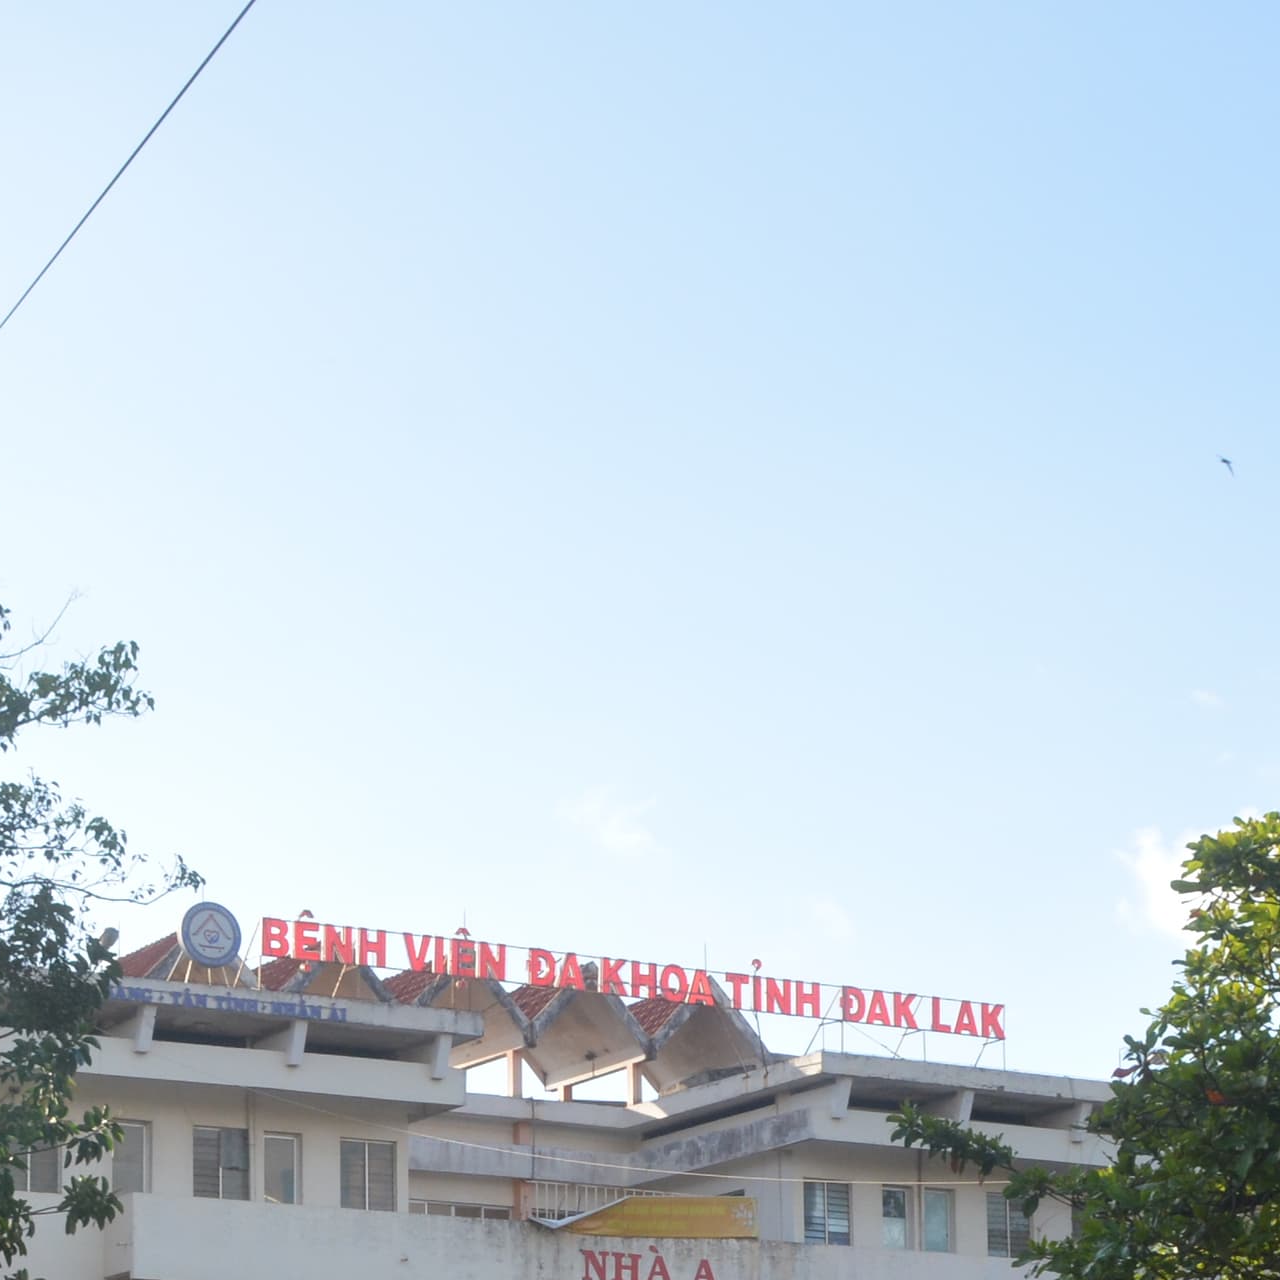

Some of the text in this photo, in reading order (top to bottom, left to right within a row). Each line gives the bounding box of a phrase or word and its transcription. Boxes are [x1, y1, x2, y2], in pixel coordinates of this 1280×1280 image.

[262, 909, 1006, 1041] BỆNH VIỆN ĐA KHOA TỈNH ĐAK LAK
